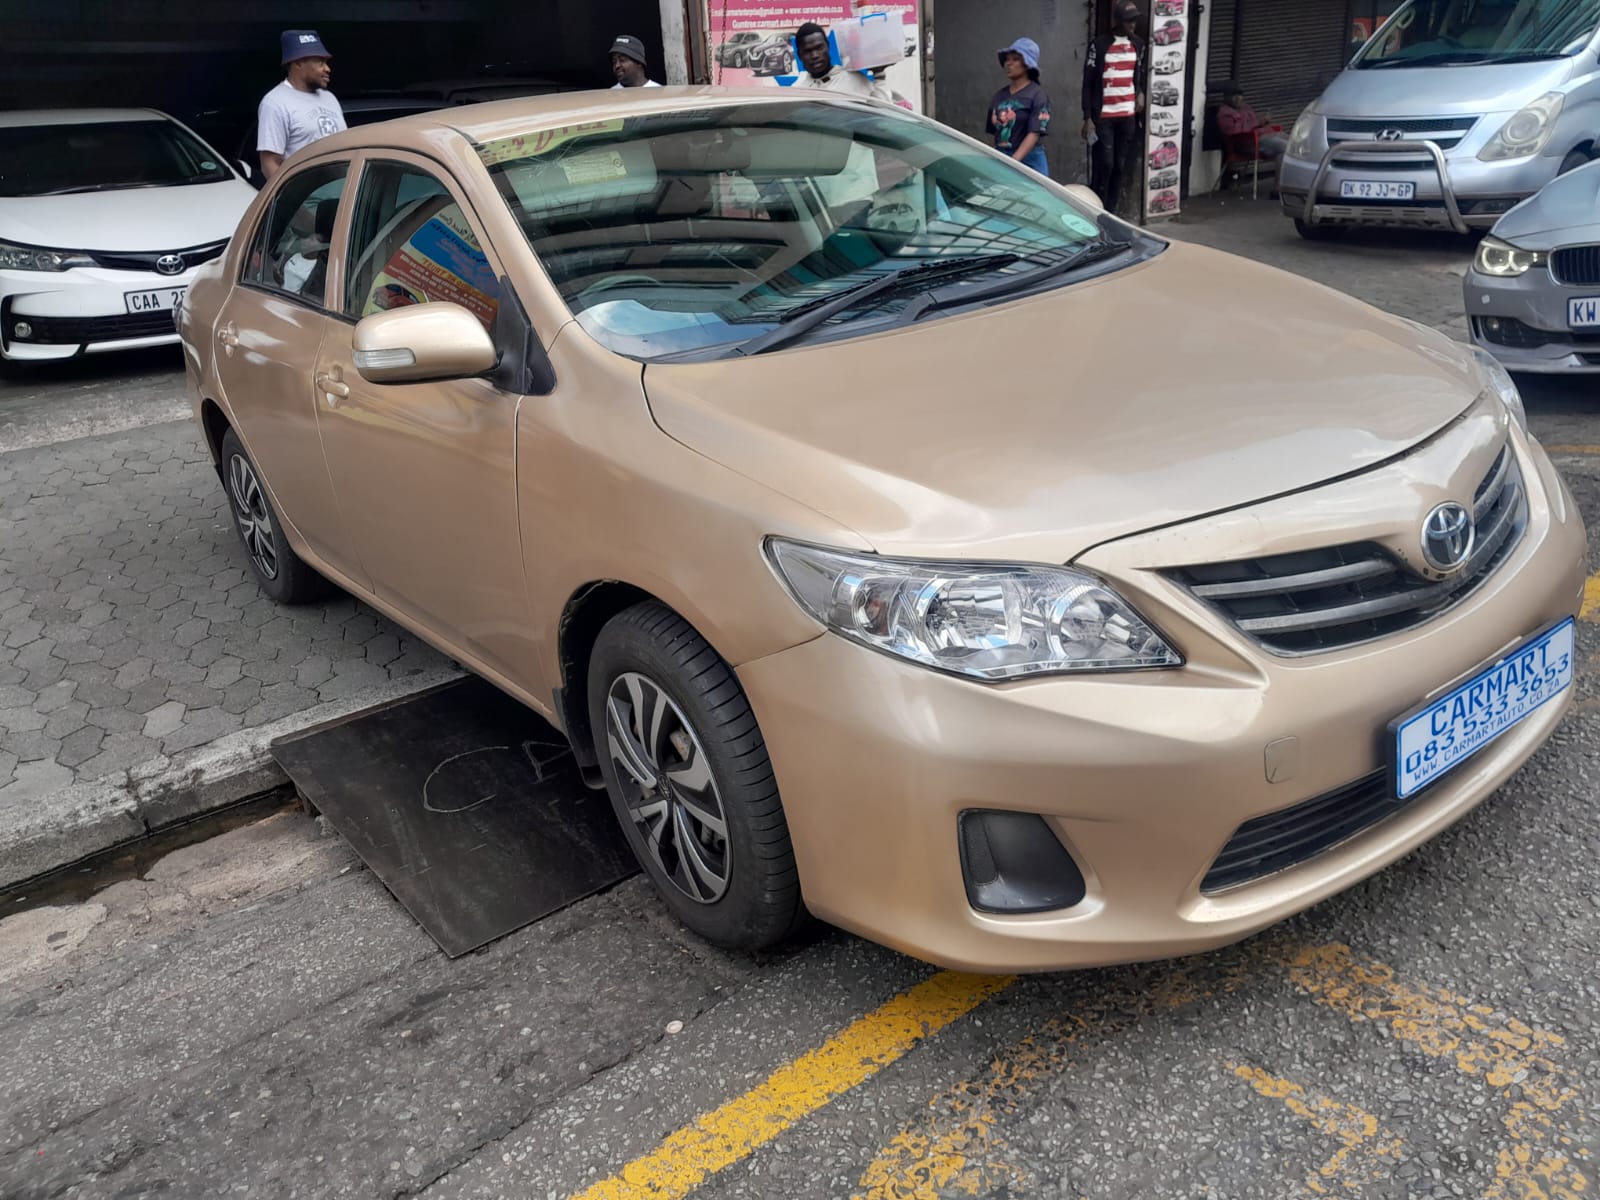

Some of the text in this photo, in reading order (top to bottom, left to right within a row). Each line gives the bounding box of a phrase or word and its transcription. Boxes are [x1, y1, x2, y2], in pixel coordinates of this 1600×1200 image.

[1360, 183, 1372, 196] 92
[1376, 183, 1389, 196] JJ
[1397, 184, 1411, 197] GP
[132, 293, 161, 311] CAA
[1574, 301, 1596, 323] KW
[1431, 639, 1551, 736] CARMART
[1406, 652, 1569, 774] 083 533 3653
